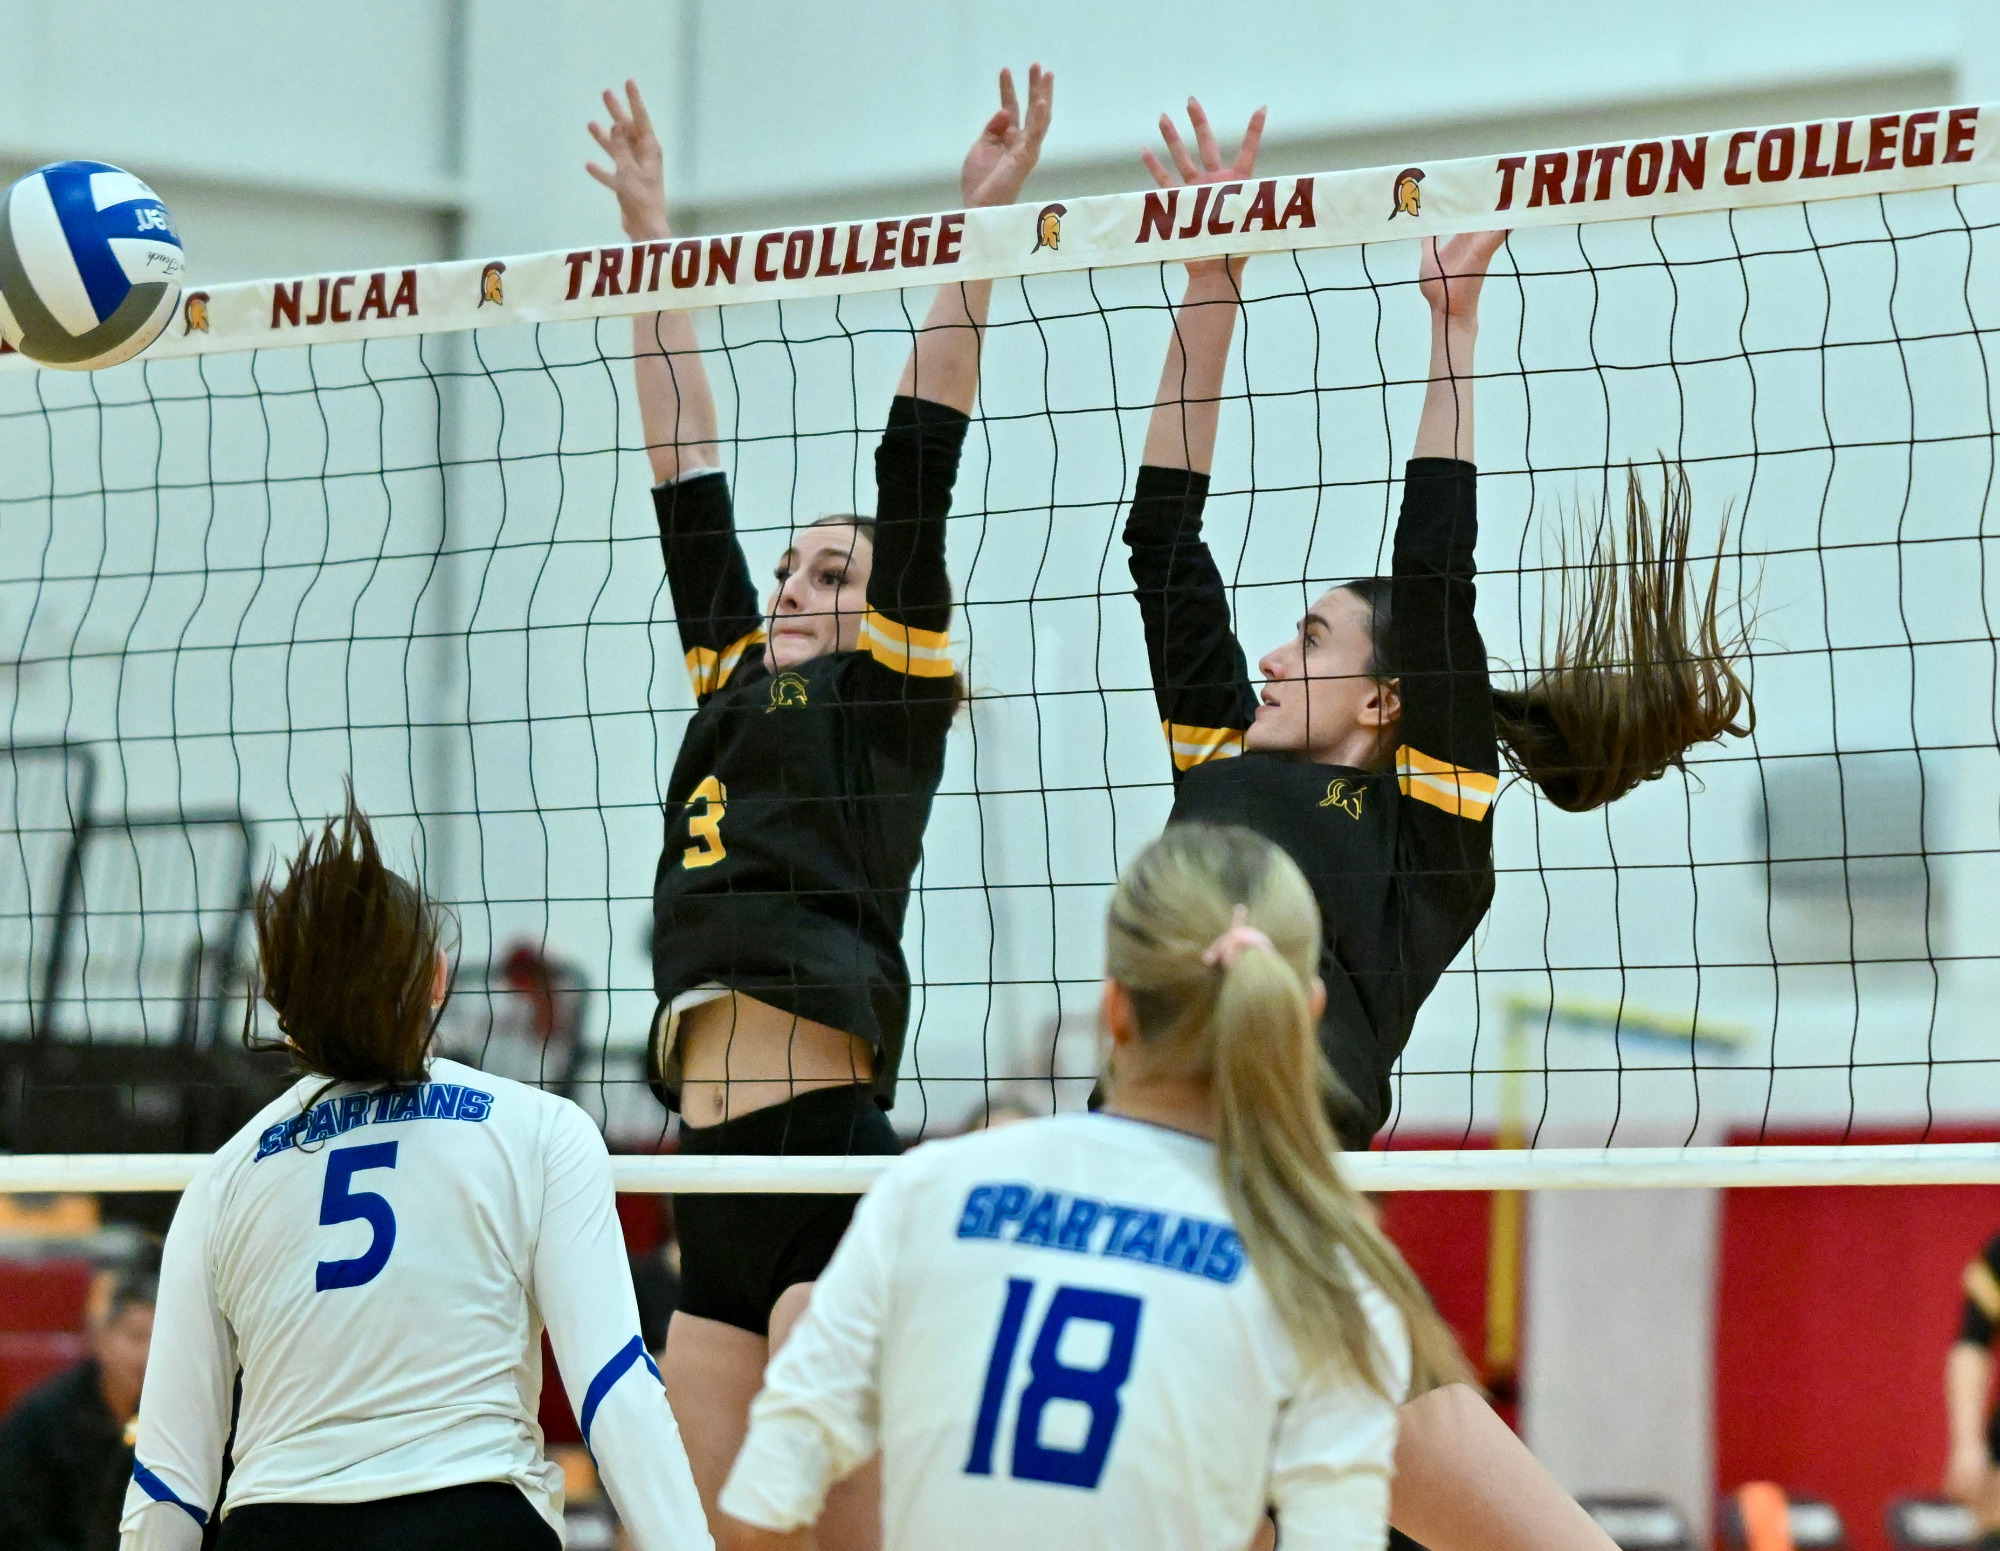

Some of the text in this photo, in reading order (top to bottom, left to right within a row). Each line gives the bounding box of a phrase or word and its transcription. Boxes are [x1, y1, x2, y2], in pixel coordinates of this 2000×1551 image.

[1494, 107, 1980, 212] TRITON COLLEGE
[564, 212, 966, 301] TRITON COLLEGE
[1134, 177, 1317, 244] NJCAA
[270, 268, 419, 329] NJCAA
[682, 774, 728, 869] 3
[253, 1083, 495, 1163] SPARTANS
[315, 1140, 399, 1293] 5
[956, 1182, 1248, 1285] SPARTANS
[963, 1275, 1144, 1490] 18
